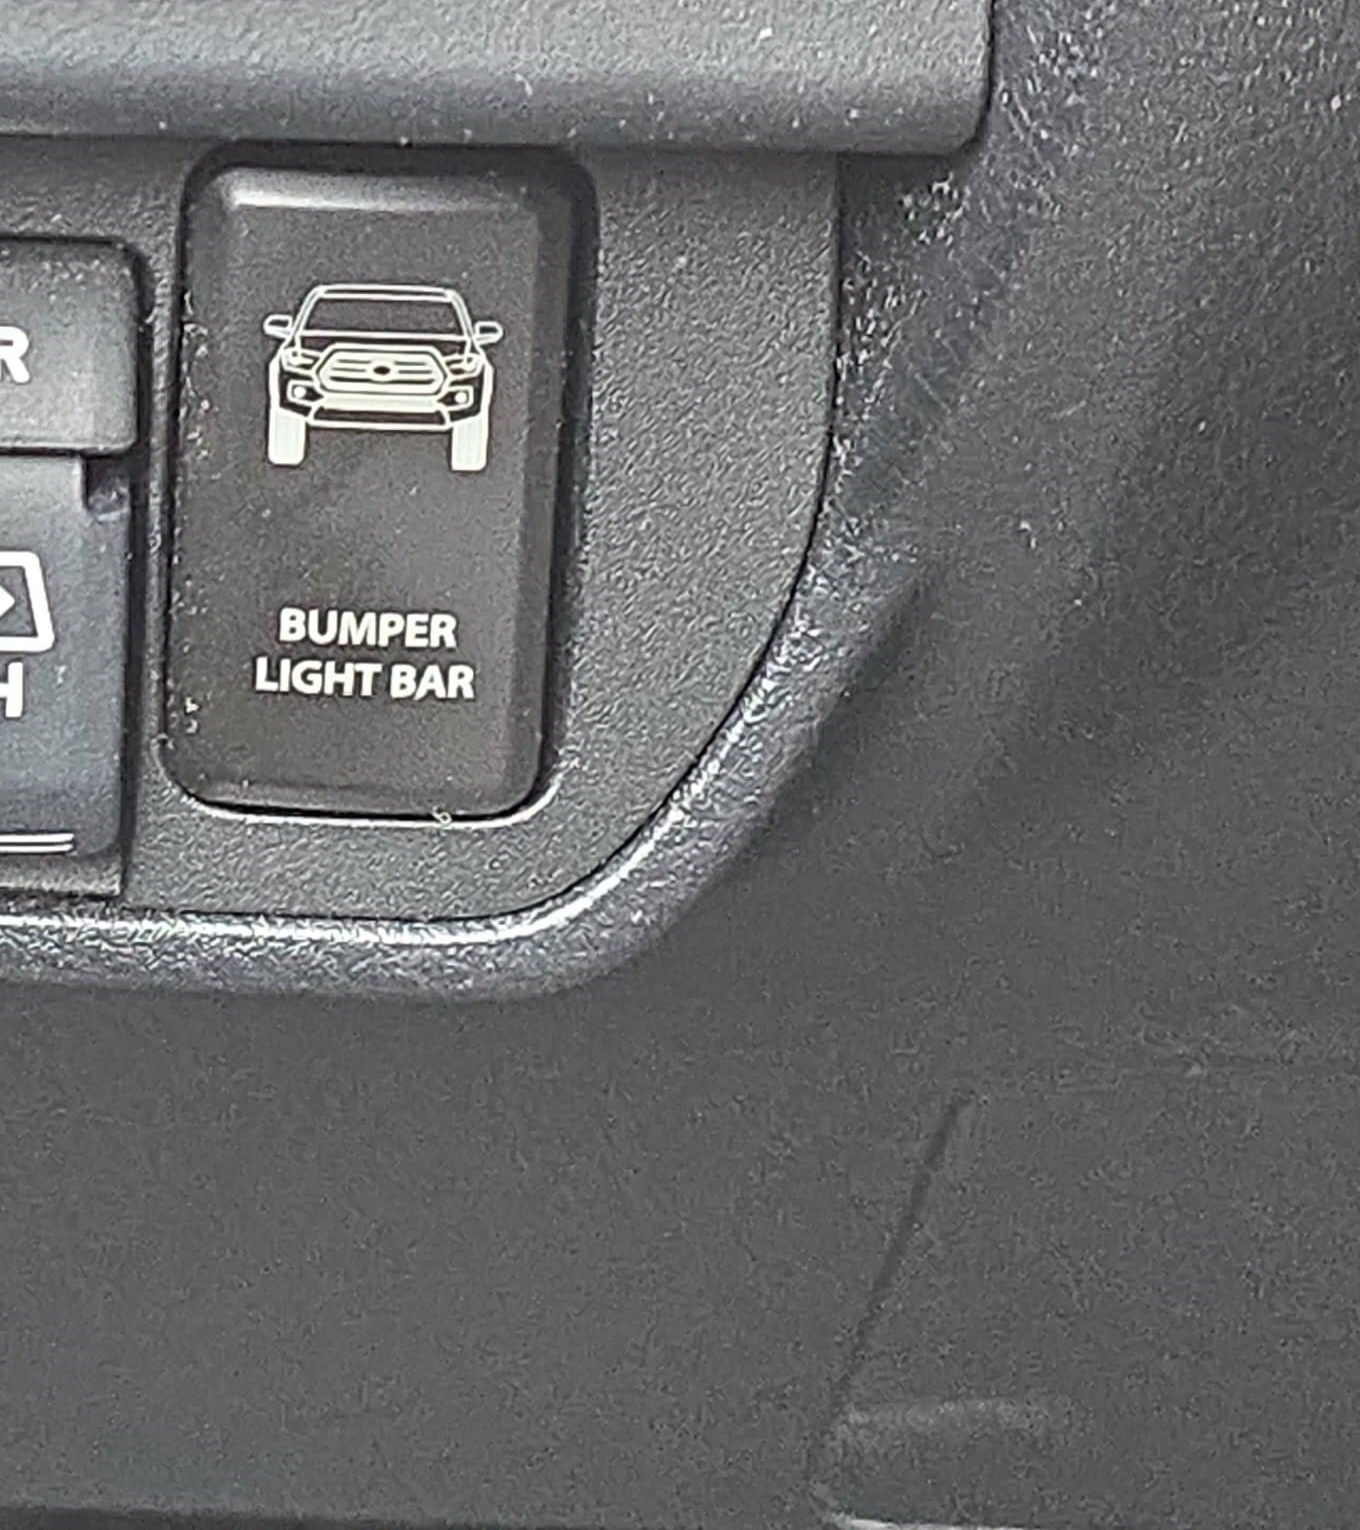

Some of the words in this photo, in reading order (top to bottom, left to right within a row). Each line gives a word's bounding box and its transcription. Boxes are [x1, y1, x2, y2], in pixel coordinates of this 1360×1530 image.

[278, 606, 458, 649] BUMPER
[254, 655, 383, 699] LIGHT
[389, 663, 475, 702] BAR
